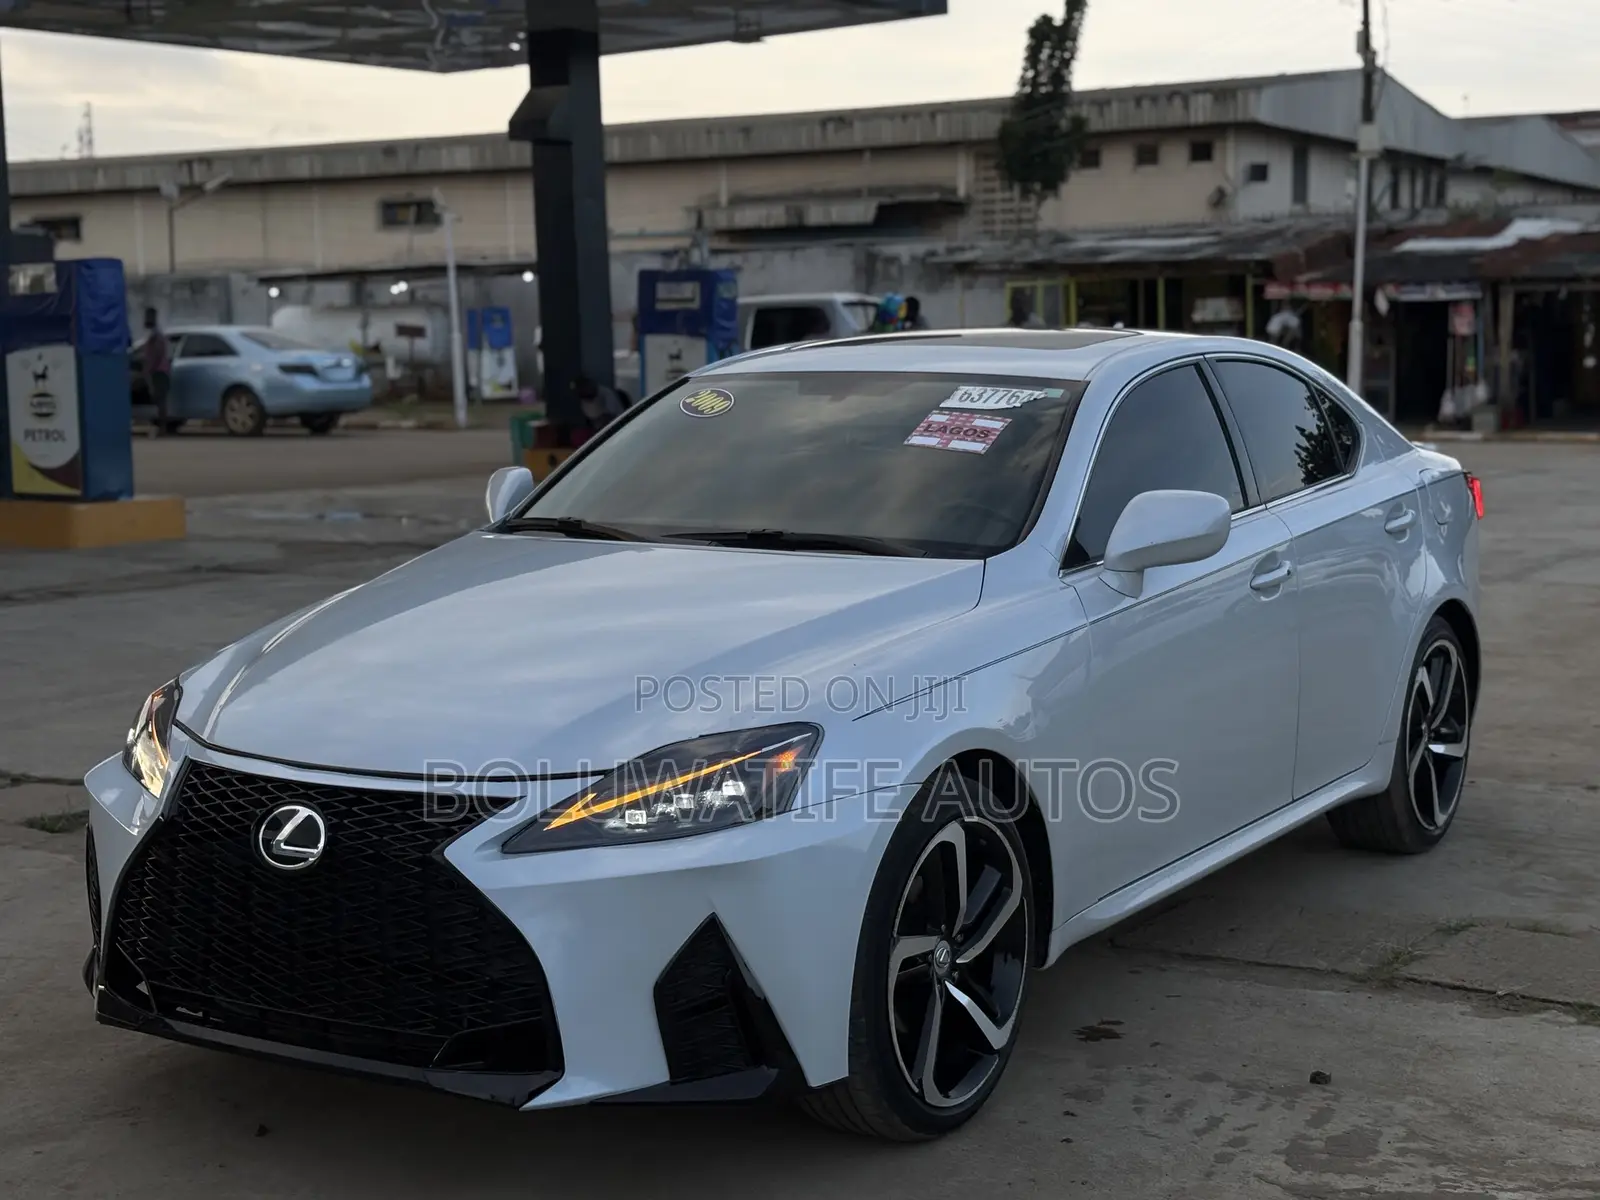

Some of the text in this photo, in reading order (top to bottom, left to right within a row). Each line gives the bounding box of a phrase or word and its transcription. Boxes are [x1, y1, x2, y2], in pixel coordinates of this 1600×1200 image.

[684, 390, 731, 414] 2009
[23, 428, 67, 443] PETROL
[923, 423, 992, 439] LAGOS
